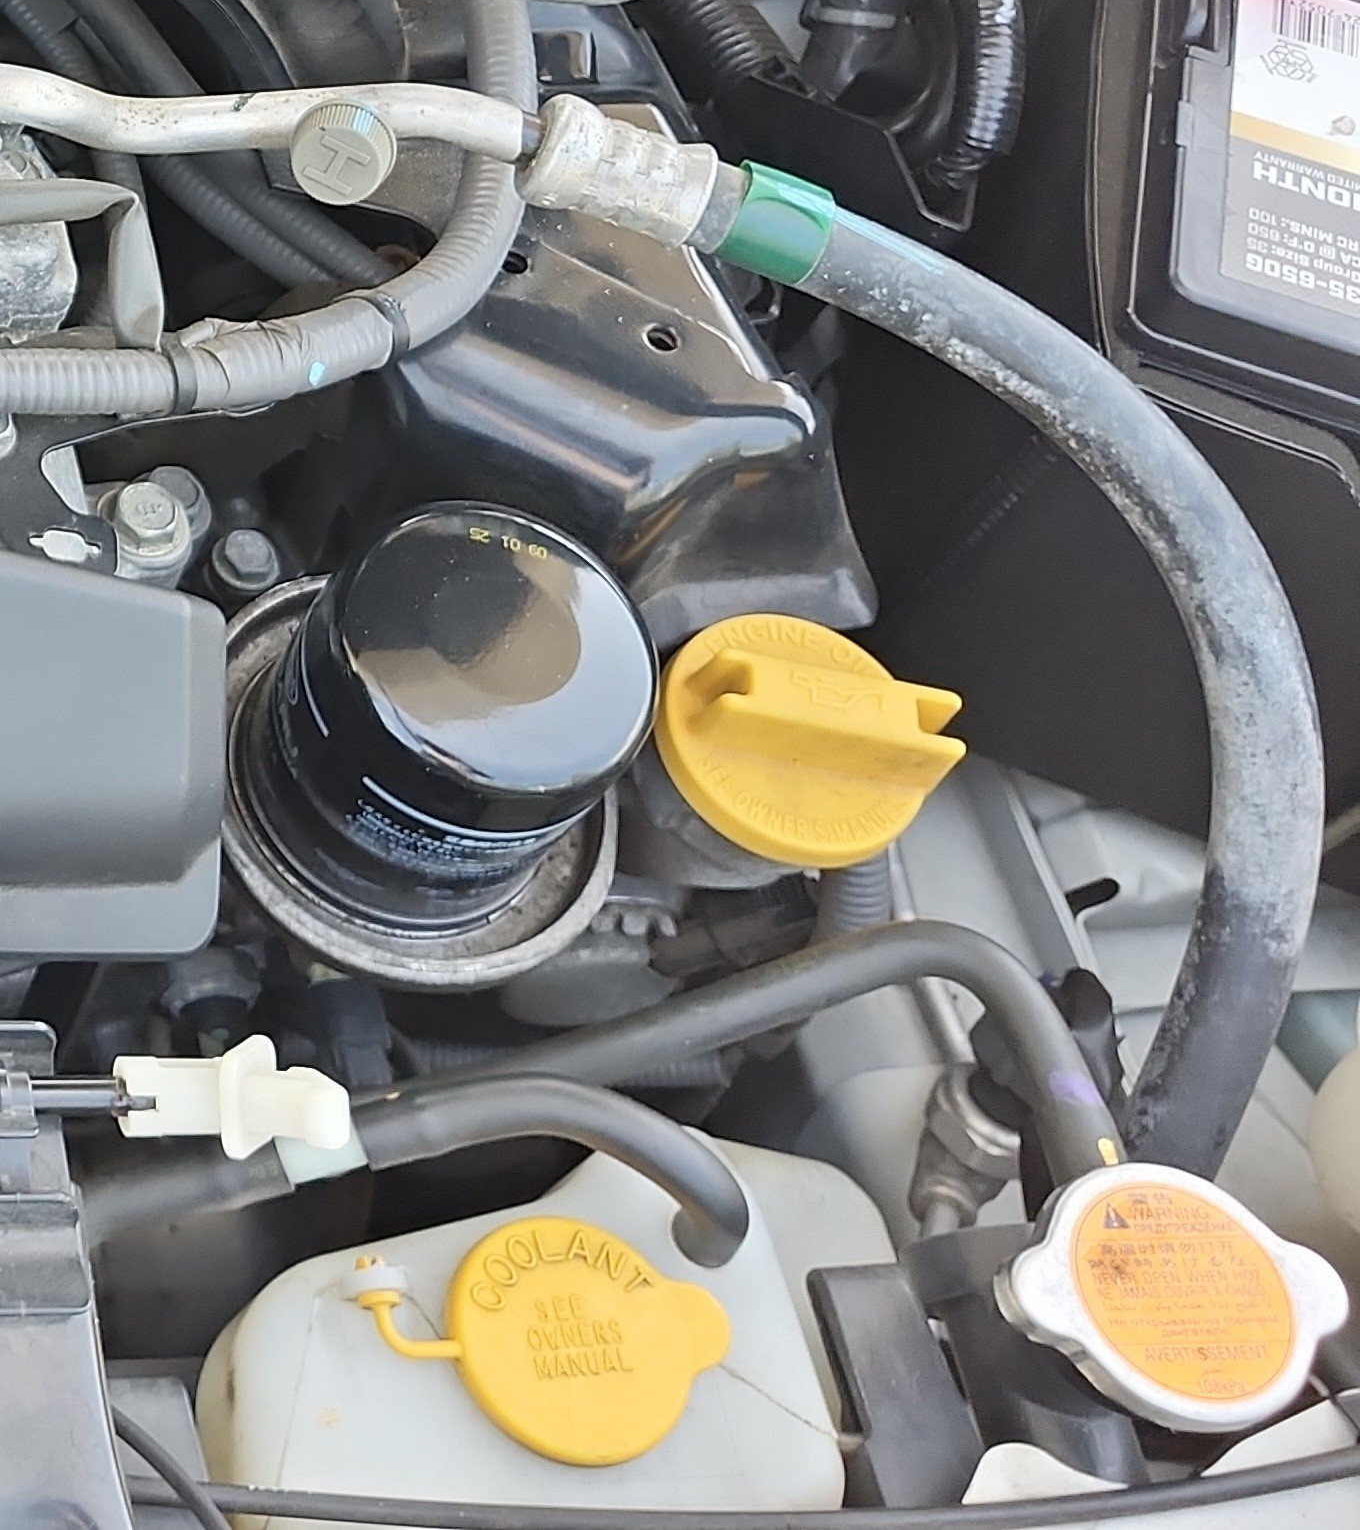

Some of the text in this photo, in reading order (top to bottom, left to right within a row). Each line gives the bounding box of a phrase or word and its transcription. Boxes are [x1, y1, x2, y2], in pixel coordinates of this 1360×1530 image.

[1248, 207, 1278, 222] 100
[1247, 222, 1280, 242] 650
[1246, 237, 1268, 254] 35
[705, 620, 819, 656] ENGINE
[1129, 1207, 1210, 1221] WARNING
[469, 1228, 654, 1311] COOLANT
[1144, 1271, 1180, 1285] OPEN
[1188, 1269, 1228, 1283] WHEN
[535, 1293, 587, 1323] SEE
[527, 1321, 624, 1352] OWNERS
[1145, 1345, 1266, 1362] AVERTISSEMENT
[533, 1348, 634, 1381] MANUAL
